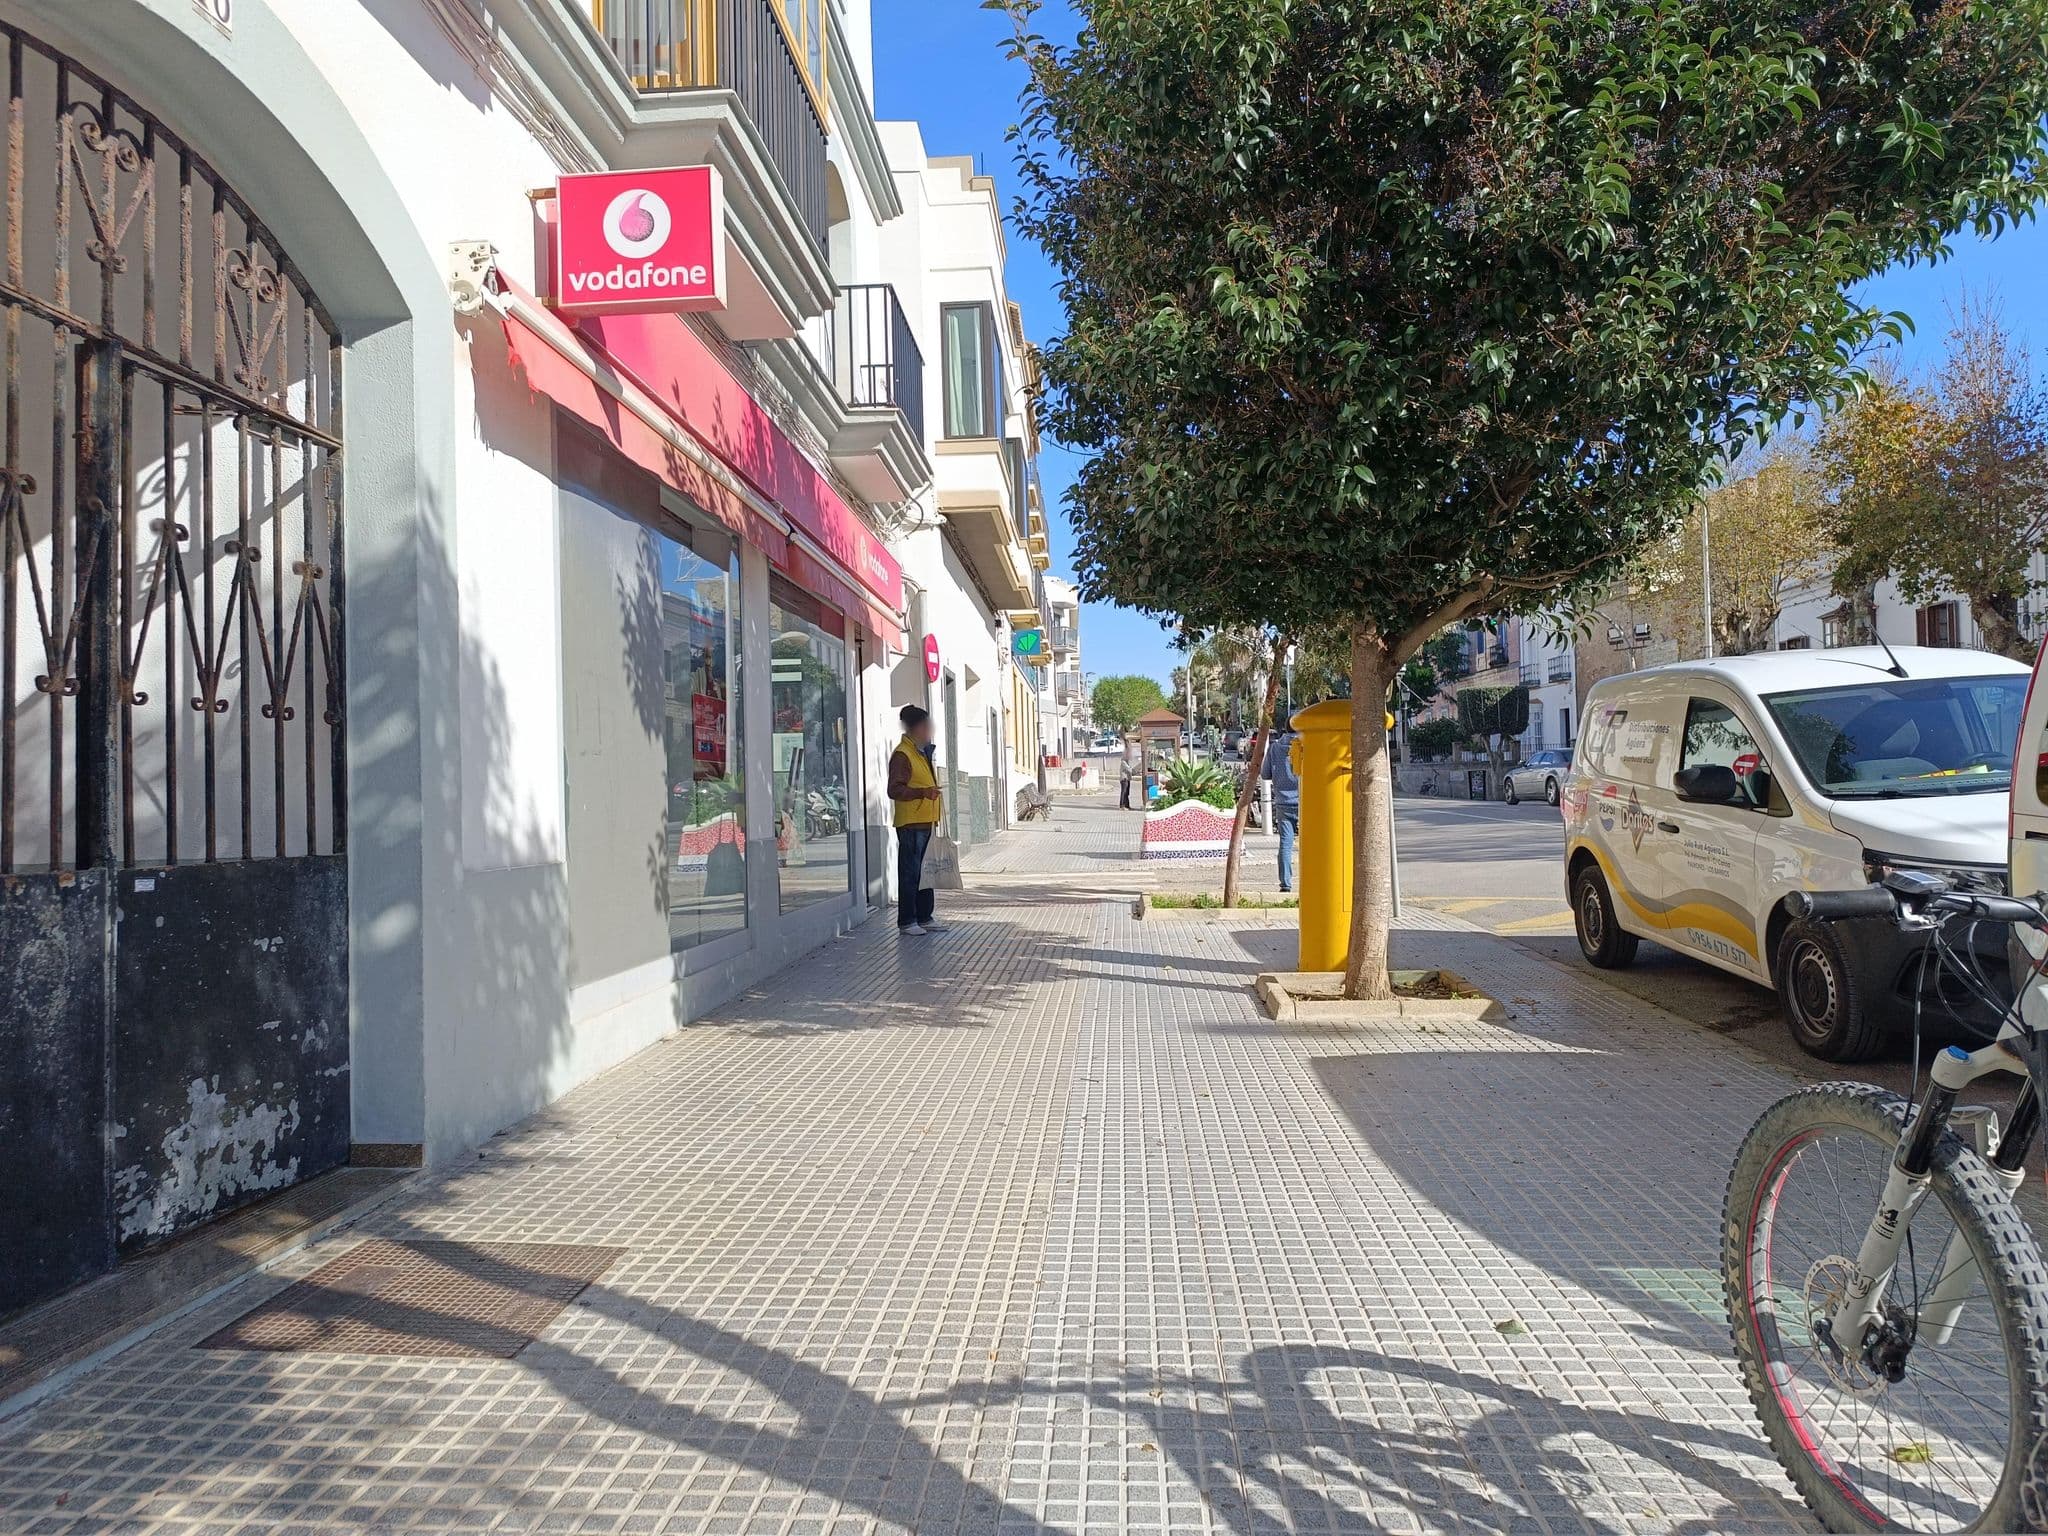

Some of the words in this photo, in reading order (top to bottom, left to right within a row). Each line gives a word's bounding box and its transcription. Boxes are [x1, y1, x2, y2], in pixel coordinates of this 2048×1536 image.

[568, 262, 707, 292] vodafone
[1599, 802, 1616, 816] PEPSI
[1621, 806, 1655, 834] Doritos
[1695, 931, 1713, 950] 956
[1713, 939, 1729, 957] 677
[1731, 946, 1747, 965] 577
[1728, 1222, 1766, 1393] MAXXIS
